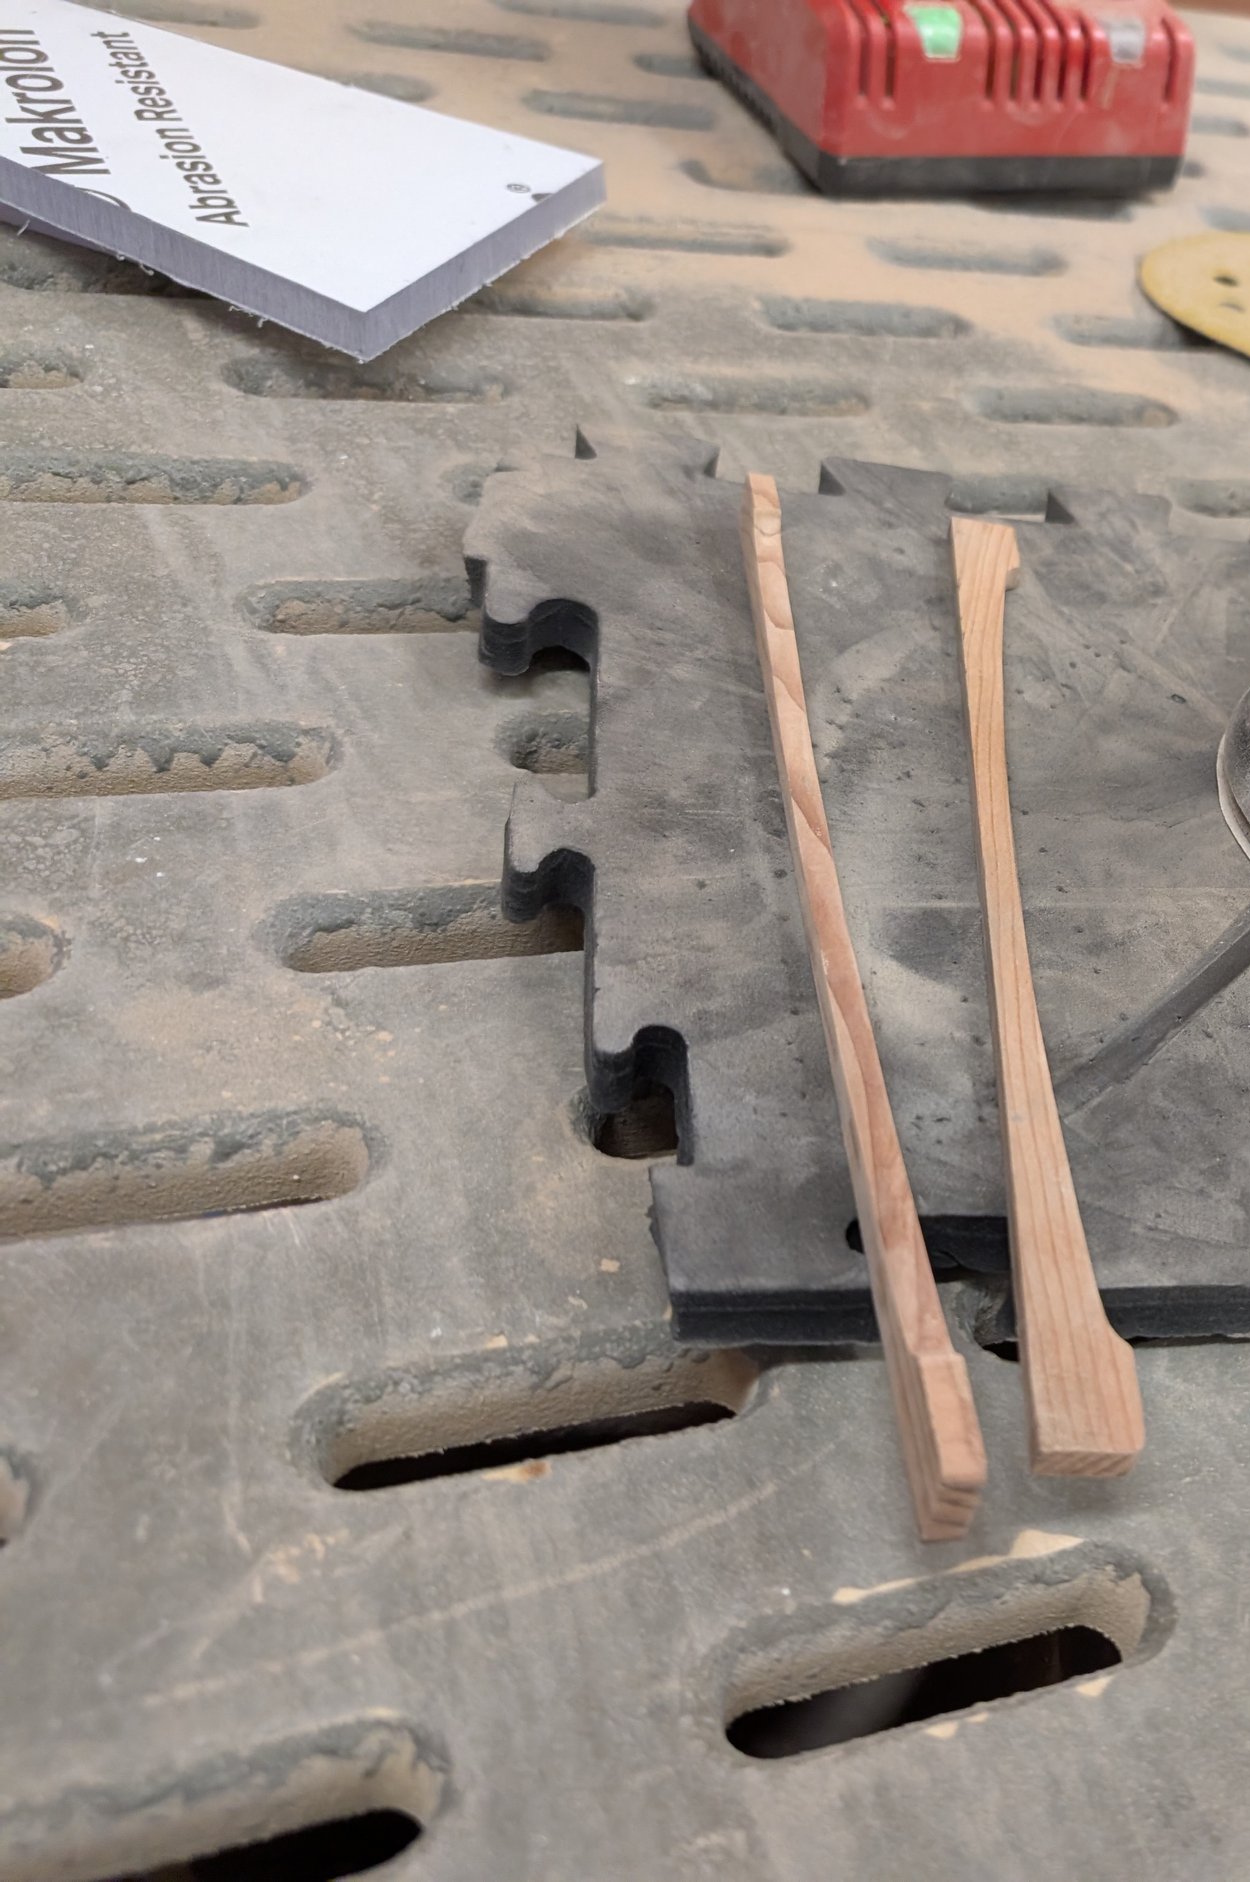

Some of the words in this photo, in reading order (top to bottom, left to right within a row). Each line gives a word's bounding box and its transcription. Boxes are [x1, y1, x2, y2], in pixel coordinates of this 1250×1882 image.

[0, 30, 111, 174] Makrolon
[90, 31, 182, 121] Resistant
[156, 128, 249, 227] Abrasion
